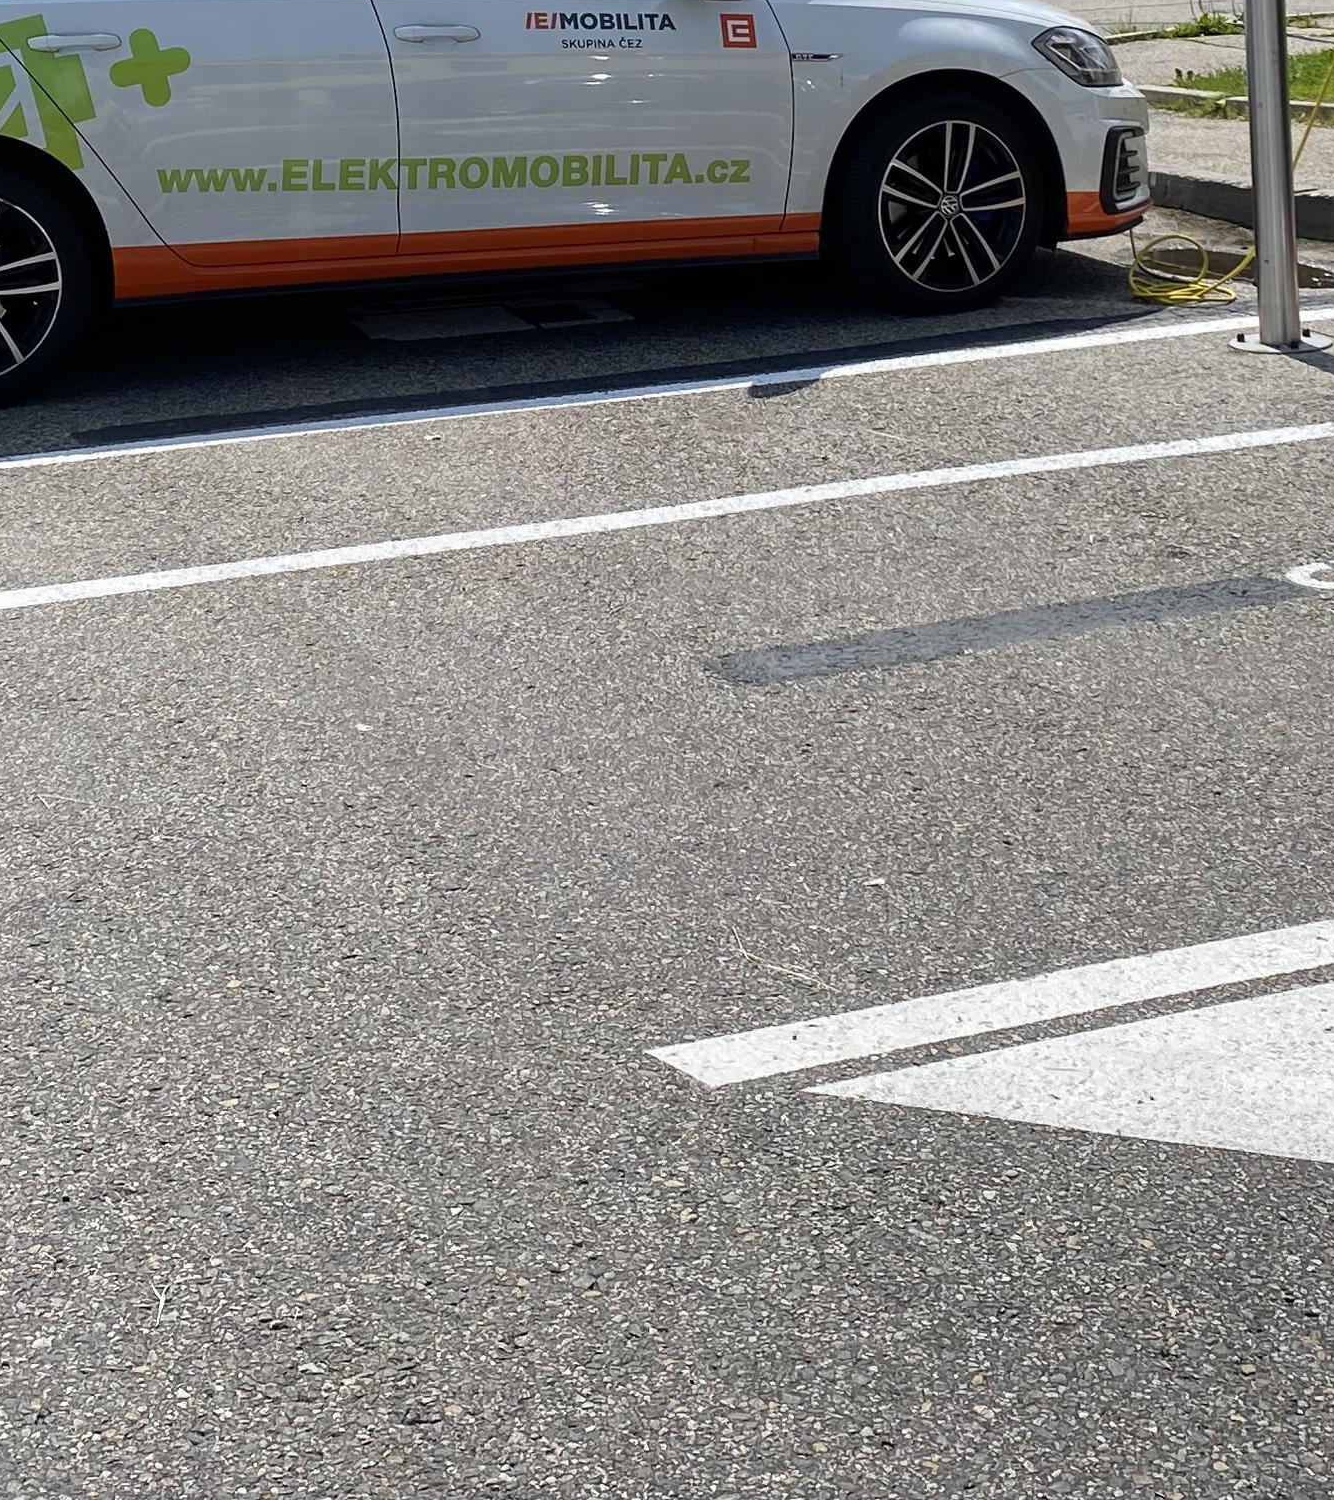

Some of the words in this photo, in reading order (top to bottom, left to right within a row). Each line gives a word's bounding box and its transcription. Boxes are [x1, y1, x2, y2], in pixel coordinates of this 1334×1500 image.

[561, 38, 616, 49] SKUPINA
[619, 36, 643, 49] ČEZ
[157, 153, 750, 192] www.ELEKTROMOBILITA.cz
